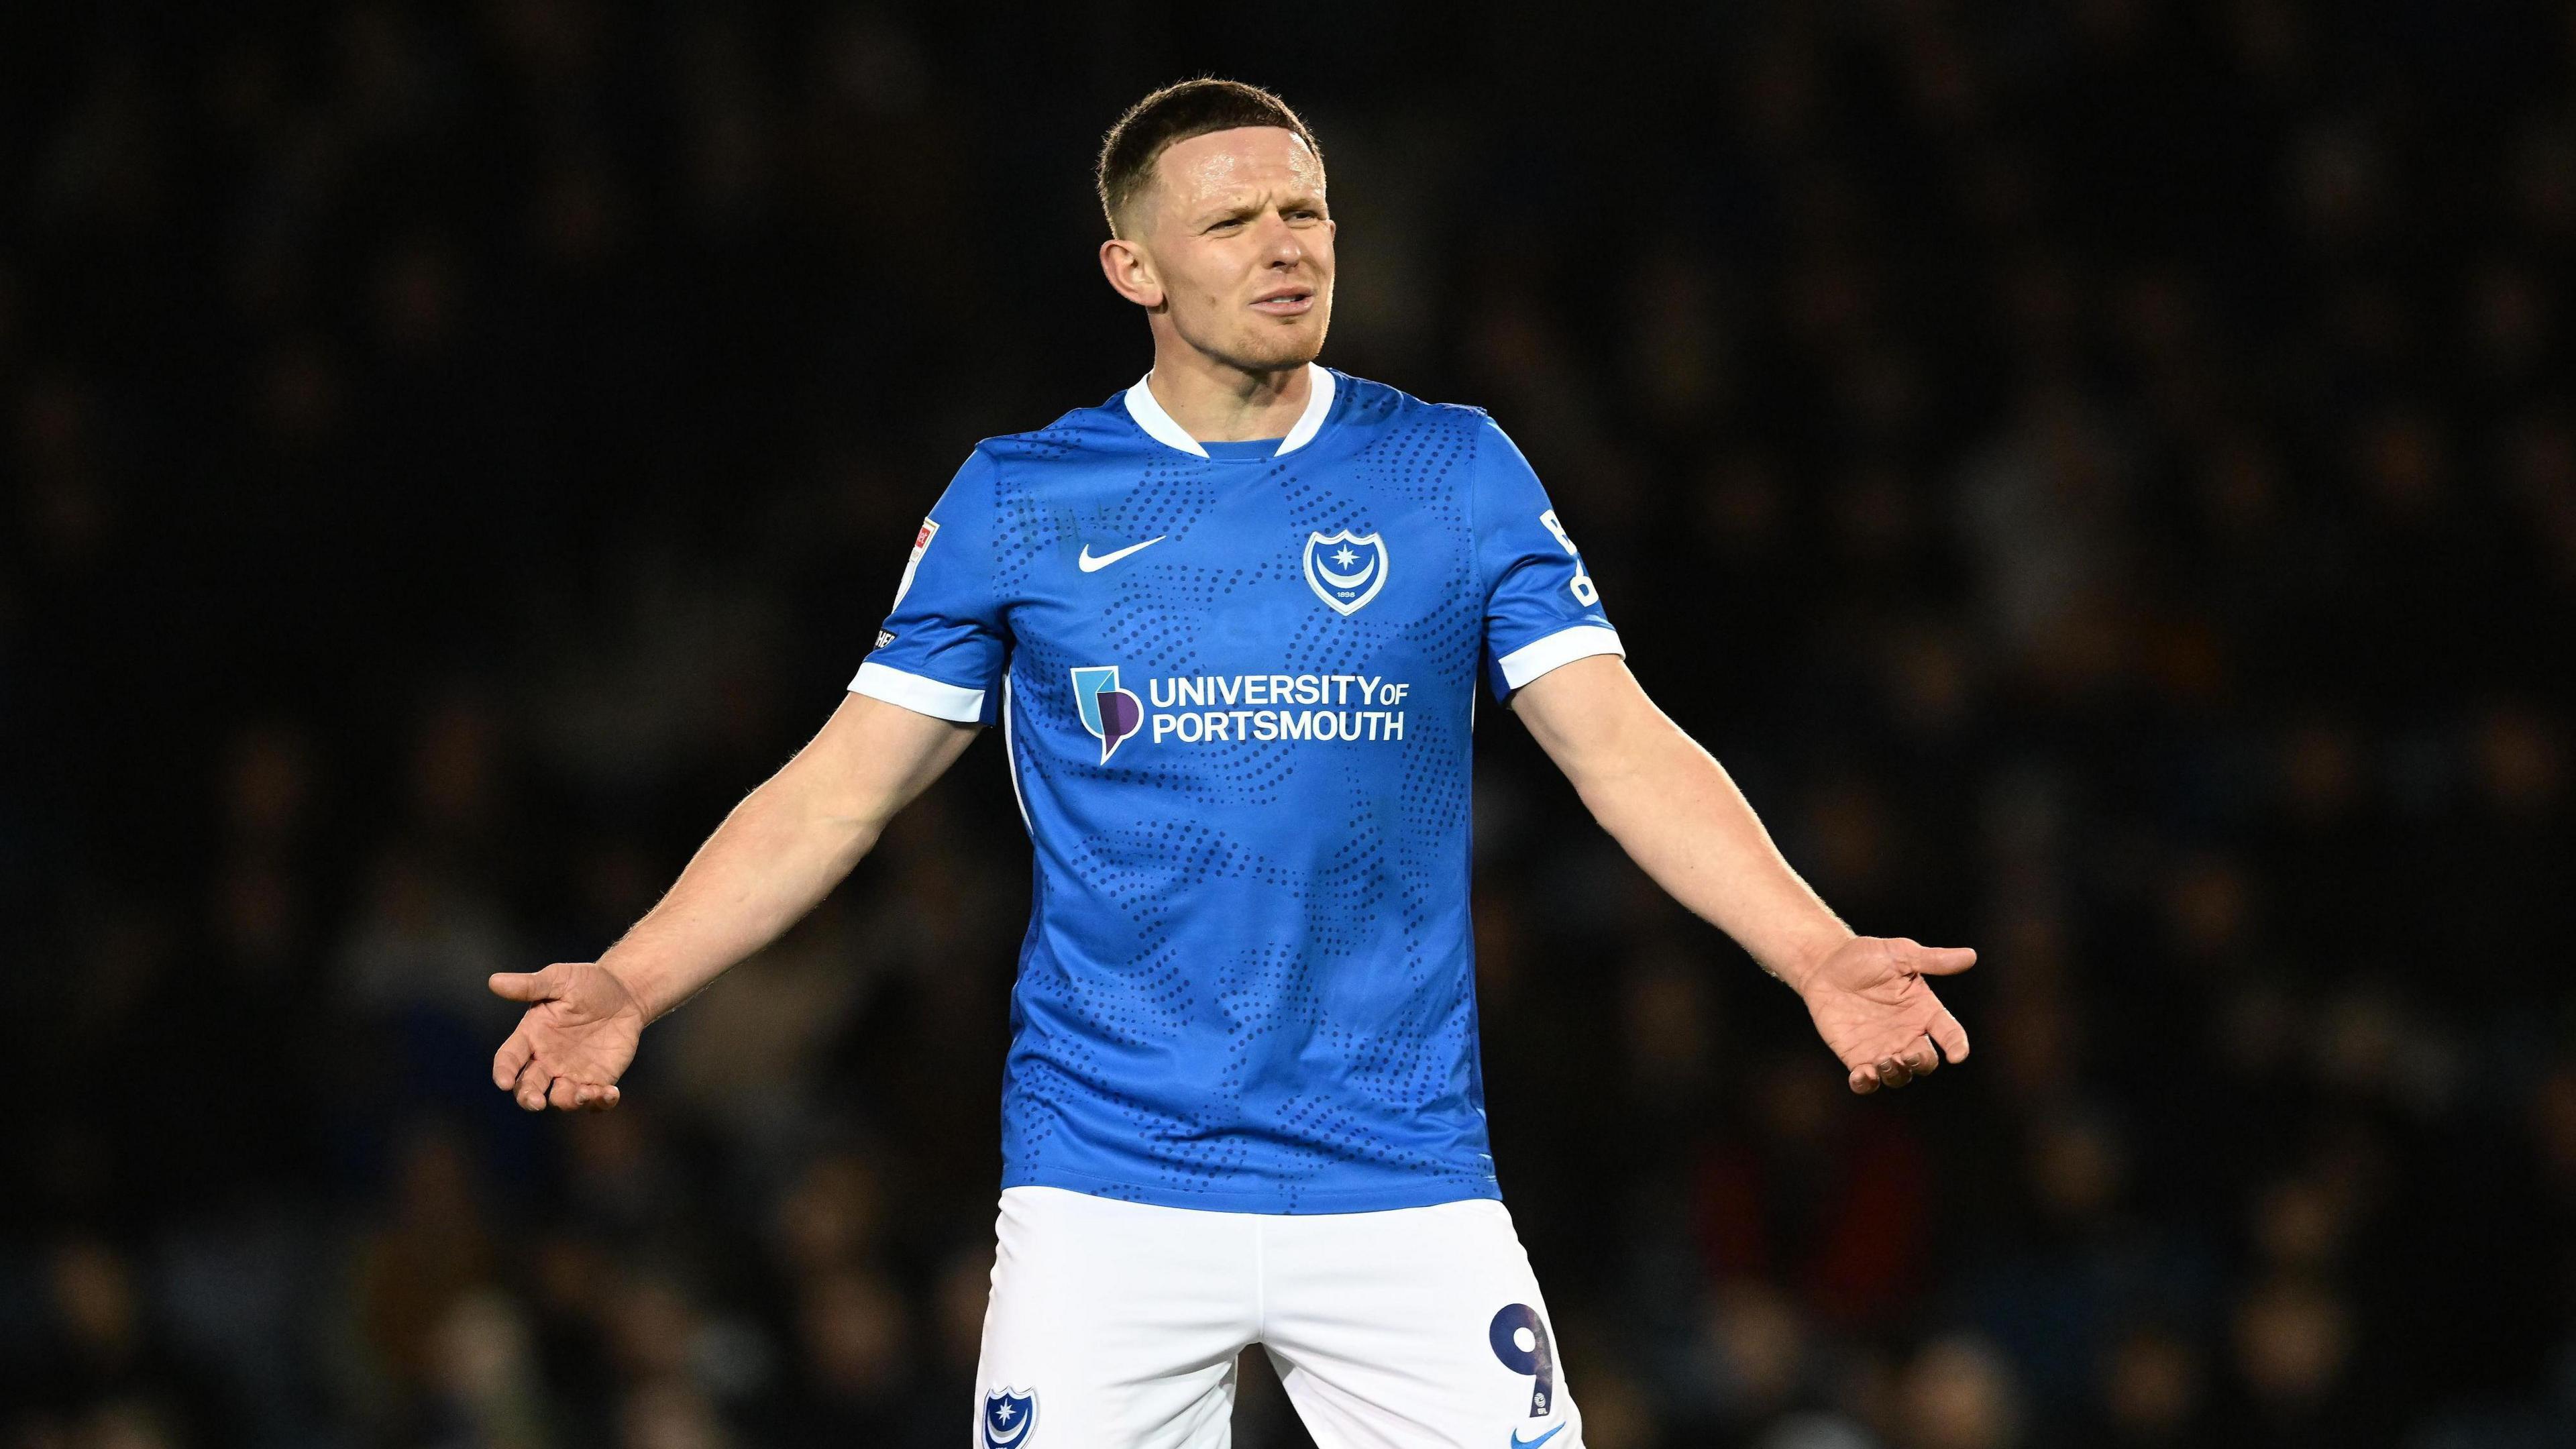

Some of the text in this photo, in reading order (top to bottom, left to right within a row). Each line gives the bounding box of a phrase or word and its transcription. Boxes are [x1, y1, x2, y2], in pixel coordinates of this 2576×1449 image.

[1150, 675, 1409, 707] UNIVERSITY OF
[1153, 710, 1404, 743] PORTSMOUTH
[1489, 1303, 1552, 1417] 9
